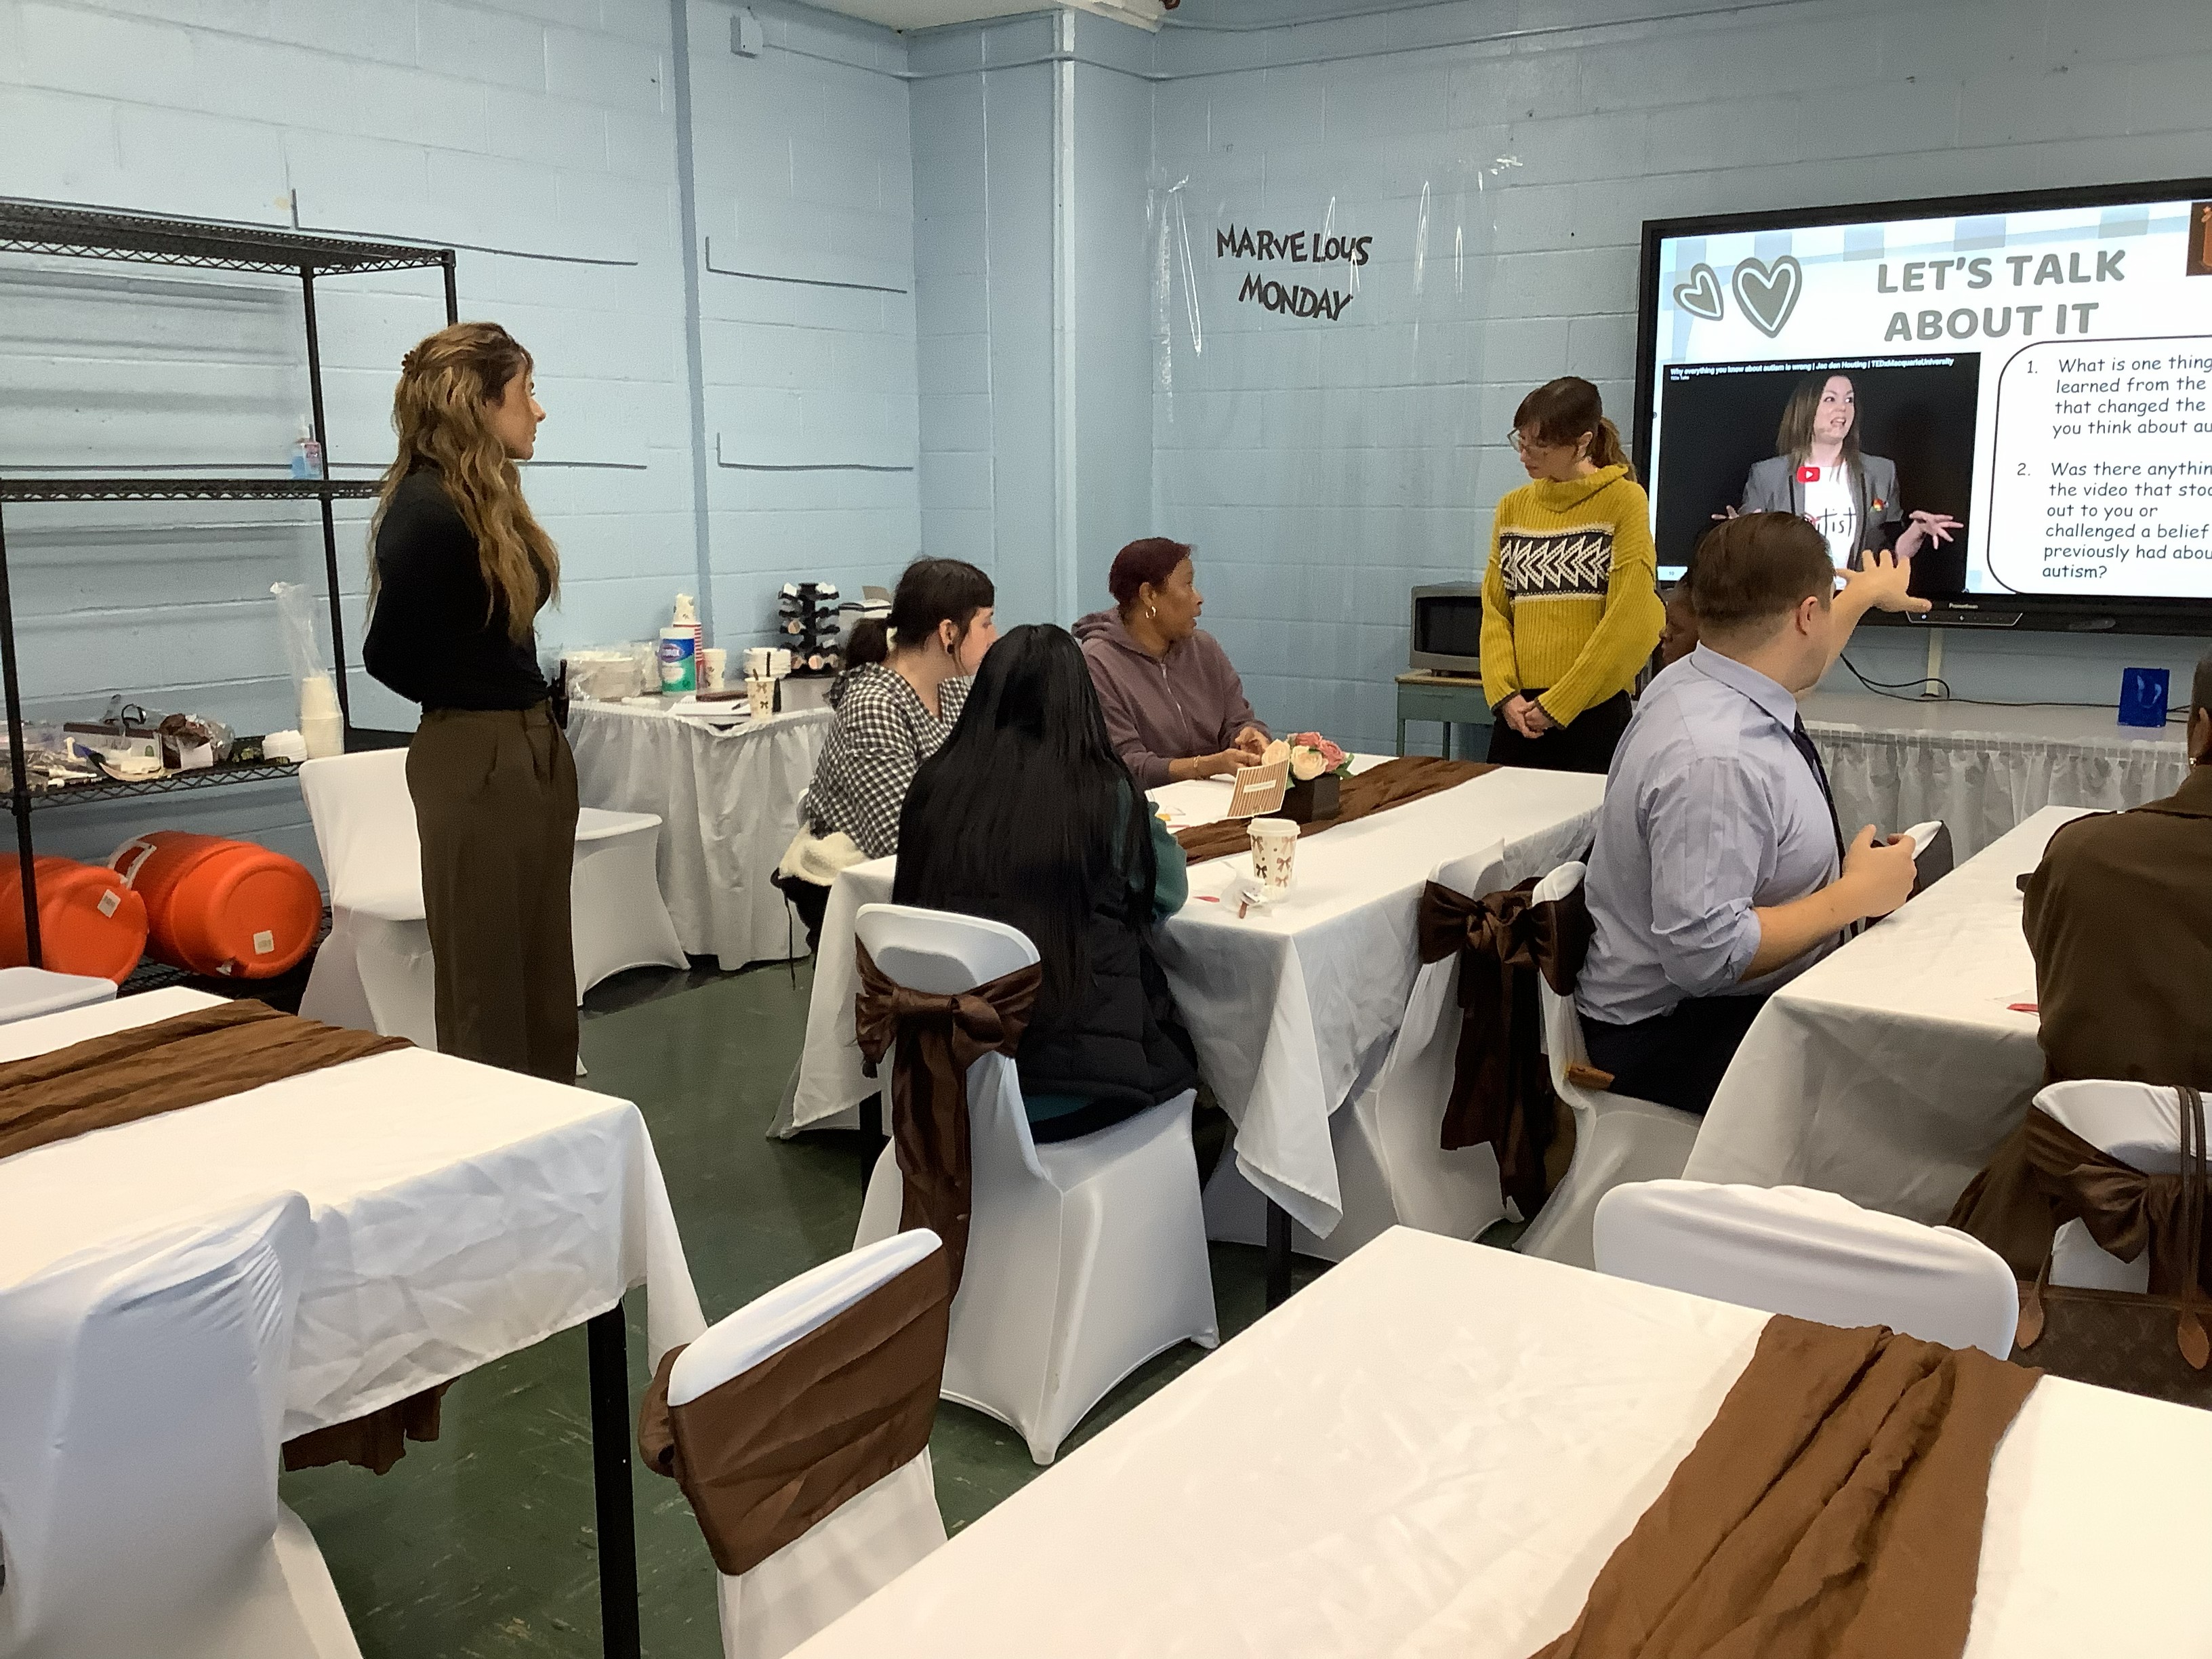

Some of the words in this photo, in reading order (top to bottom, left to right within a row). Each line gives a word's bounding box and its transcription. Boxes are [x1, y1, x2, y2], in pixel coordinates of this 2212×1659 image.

[1877, 257, 1992, 293] LET'S
[2005, 249, 2125, 286] TALK
[1239, 272, 1353, 321] MONDAY
[1884, 305, 2043, 342] ABOUT
[2056, 302, 2099, 335] IT
[1671, 368, 1684, 376] Why
[1684, 366, 1715, 375] everything
[1716, 367, 1727, 375] you
[1792, 363, 1811, 371] wrong
[2027, 361, 2038, 373] 1.
[2059, 358, 2105, 373] What
[2112, 357, 2125, 371] is
[2131, 359, 2161, 370] one
[2168, 354, 2212, 373] thing
[2056, 377, 2120, 393] learned
[2127, 377, 2169, 392] from
[2176, 376, 2207, 390] the
[2055, 400, 2091, 413] that
[2097, 397, 2169, 417] changed
[2176, 396, 2206, 411] the
[2053, 424, 2081, 439] you
[2088, 419, 2131, 434] think
[2137, 419, 2188, 433] about
[2017, 462, 2030, 476] 2.
[2051, 462, 2087, 476] Was
[2093, 462, 2141, 475] there
[2049, 483, 2077, 496] the
[2084, 483, 2127, 496] video
[2135, 482, 2172, 496] that
[2047, 504, 2074, 516] out
[2081, 504, 2097, 516] to
[2104, 508, 2133, 521] you
[2139, 508, 2158, 517] or
[2045, 523, 2135, 541] challenged
[2142, 527, 2150, 537] a
[2157, 523, 2209, 539] belief
[2044, 544, 2129, 562] previously
[2136, 544, 2167, 559] had
[2043, 565, 2107, 578] autism?
